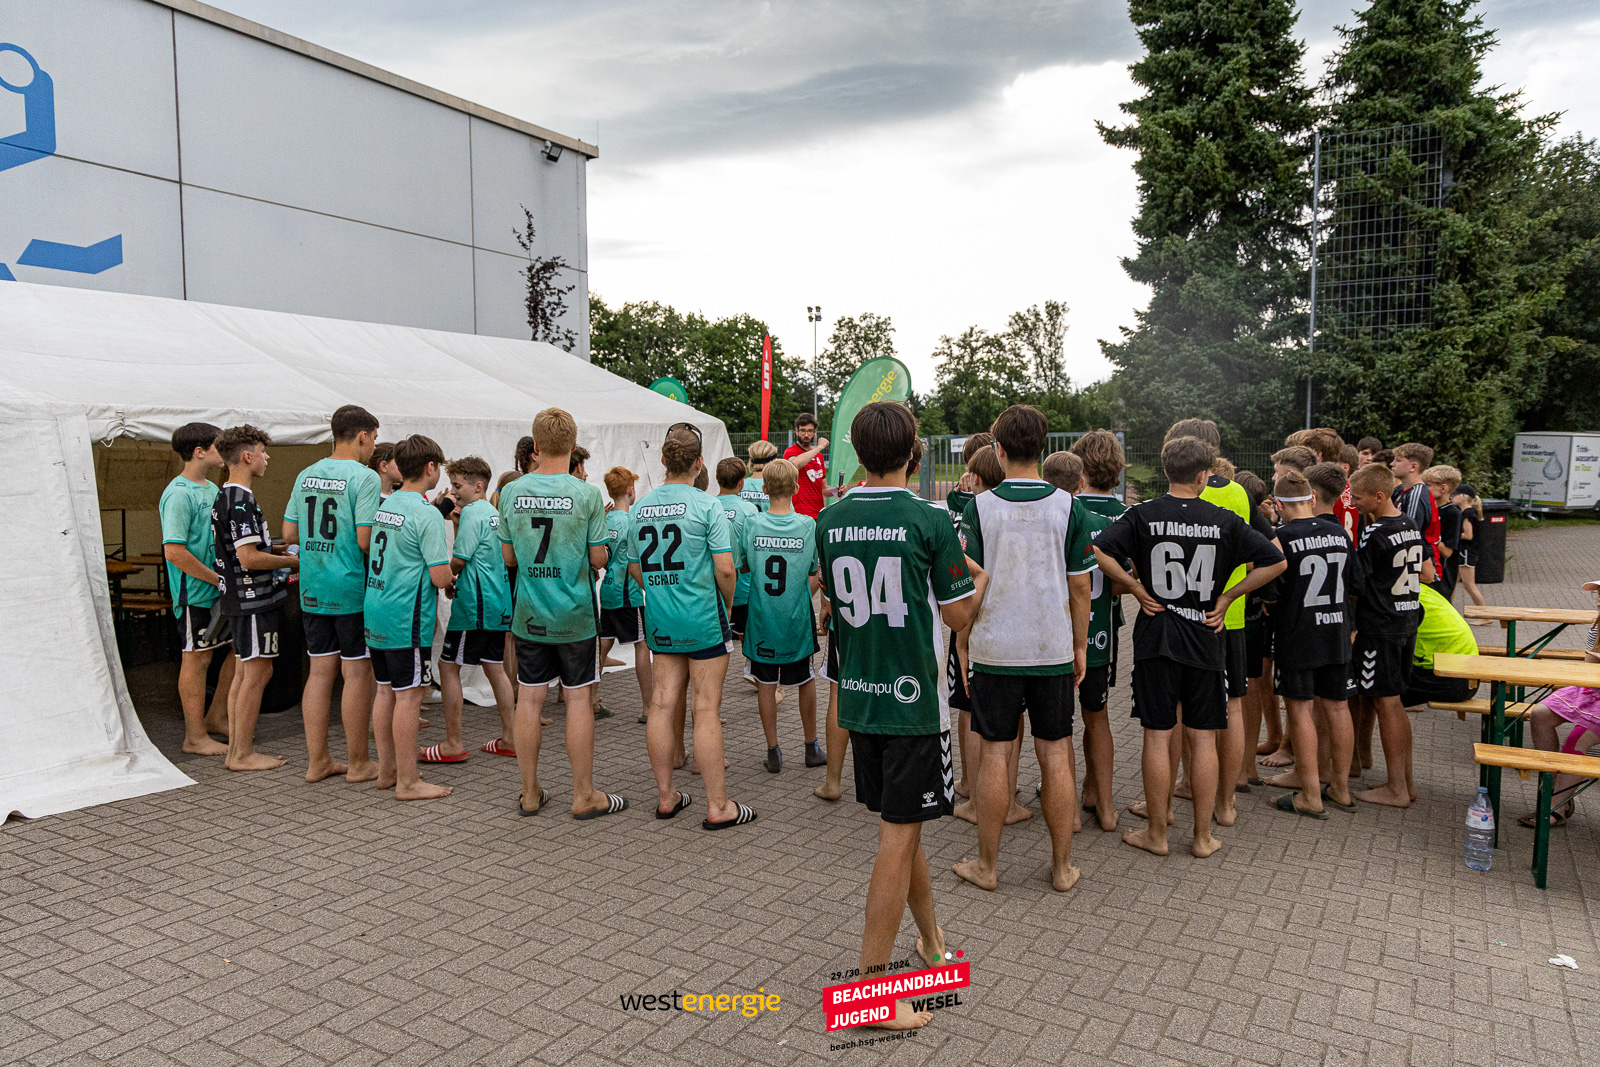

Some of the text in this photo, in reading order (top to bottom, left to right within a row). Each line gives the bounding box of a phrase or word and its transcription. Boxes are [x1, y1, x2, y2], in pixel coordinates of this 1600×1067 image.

[302, 477, 347, 491] JUNIORS
[514, 495, 573, 510] JUNIORS
[636, 503, 687, 519] JUNIORS
[304, 495, 338, 541] 16
[828, 525, 907, 544] TV Aldekerk
[1148, 521, 1221, 539] TV Aldekerk
[1388, 532, 1402, 546] TV
[305, 541, 335, 553] GUTZEIT
[531, 517, 554, 564] 7
[638, 523, 685, 572] 22
[753, 535, 804, 550] JUNIORS
[1288, 534, 1348, 554] TV Aldekerk
[371, 531, 388, 576] 3
[528, 567, 562, 578] SCHADE
[648, 574, 679, 586] SCHADE
[764, 555, 787, 596] 9
[1150, 541, 1217, 602] 64
[1299, 552, 1348, 608] 27
[1391, 545, 1423, 596] 23
[831, 556, 909, 628] 94
[263, 632, 278, 654] 18
